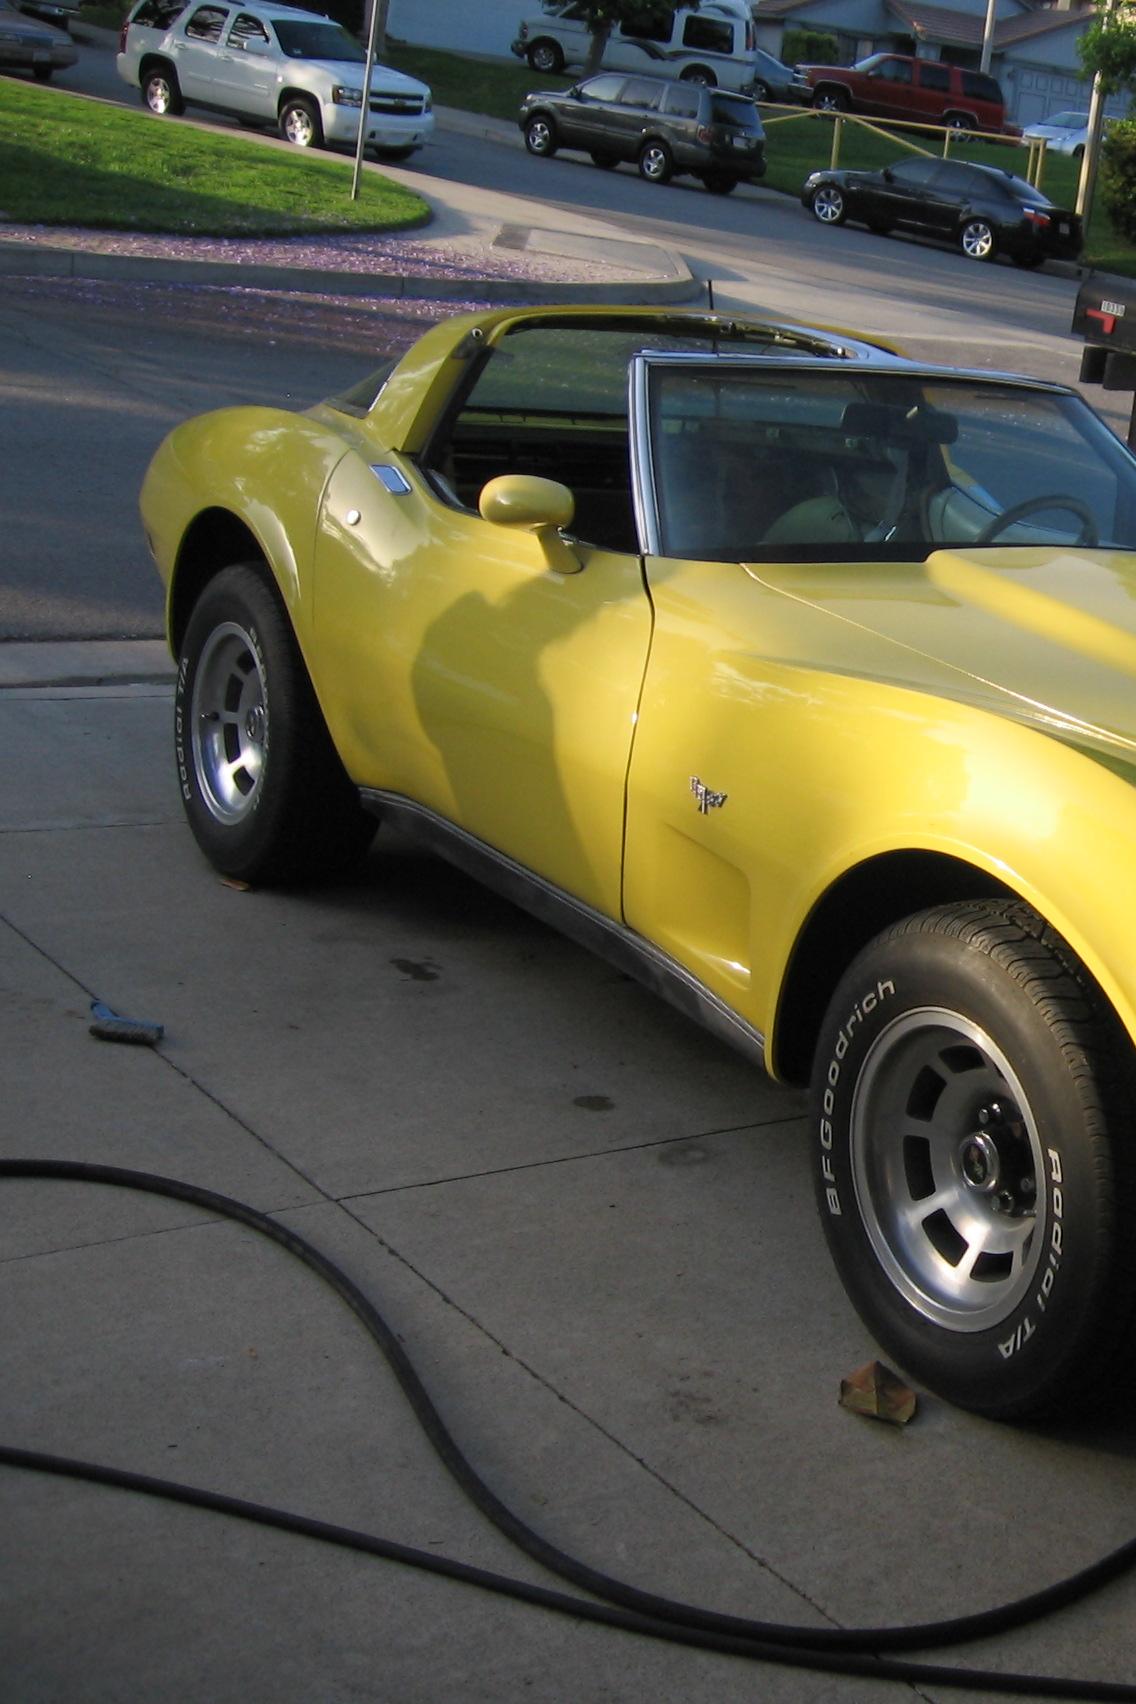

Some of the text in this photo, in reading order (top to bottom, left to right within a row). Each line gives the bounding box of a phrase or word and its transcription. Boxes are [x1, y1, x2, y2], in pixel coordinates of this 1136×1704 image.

[820, 978, 896, 1216] BFGoodrich
[997, 1147, 1065, 1359] Radial T/A
